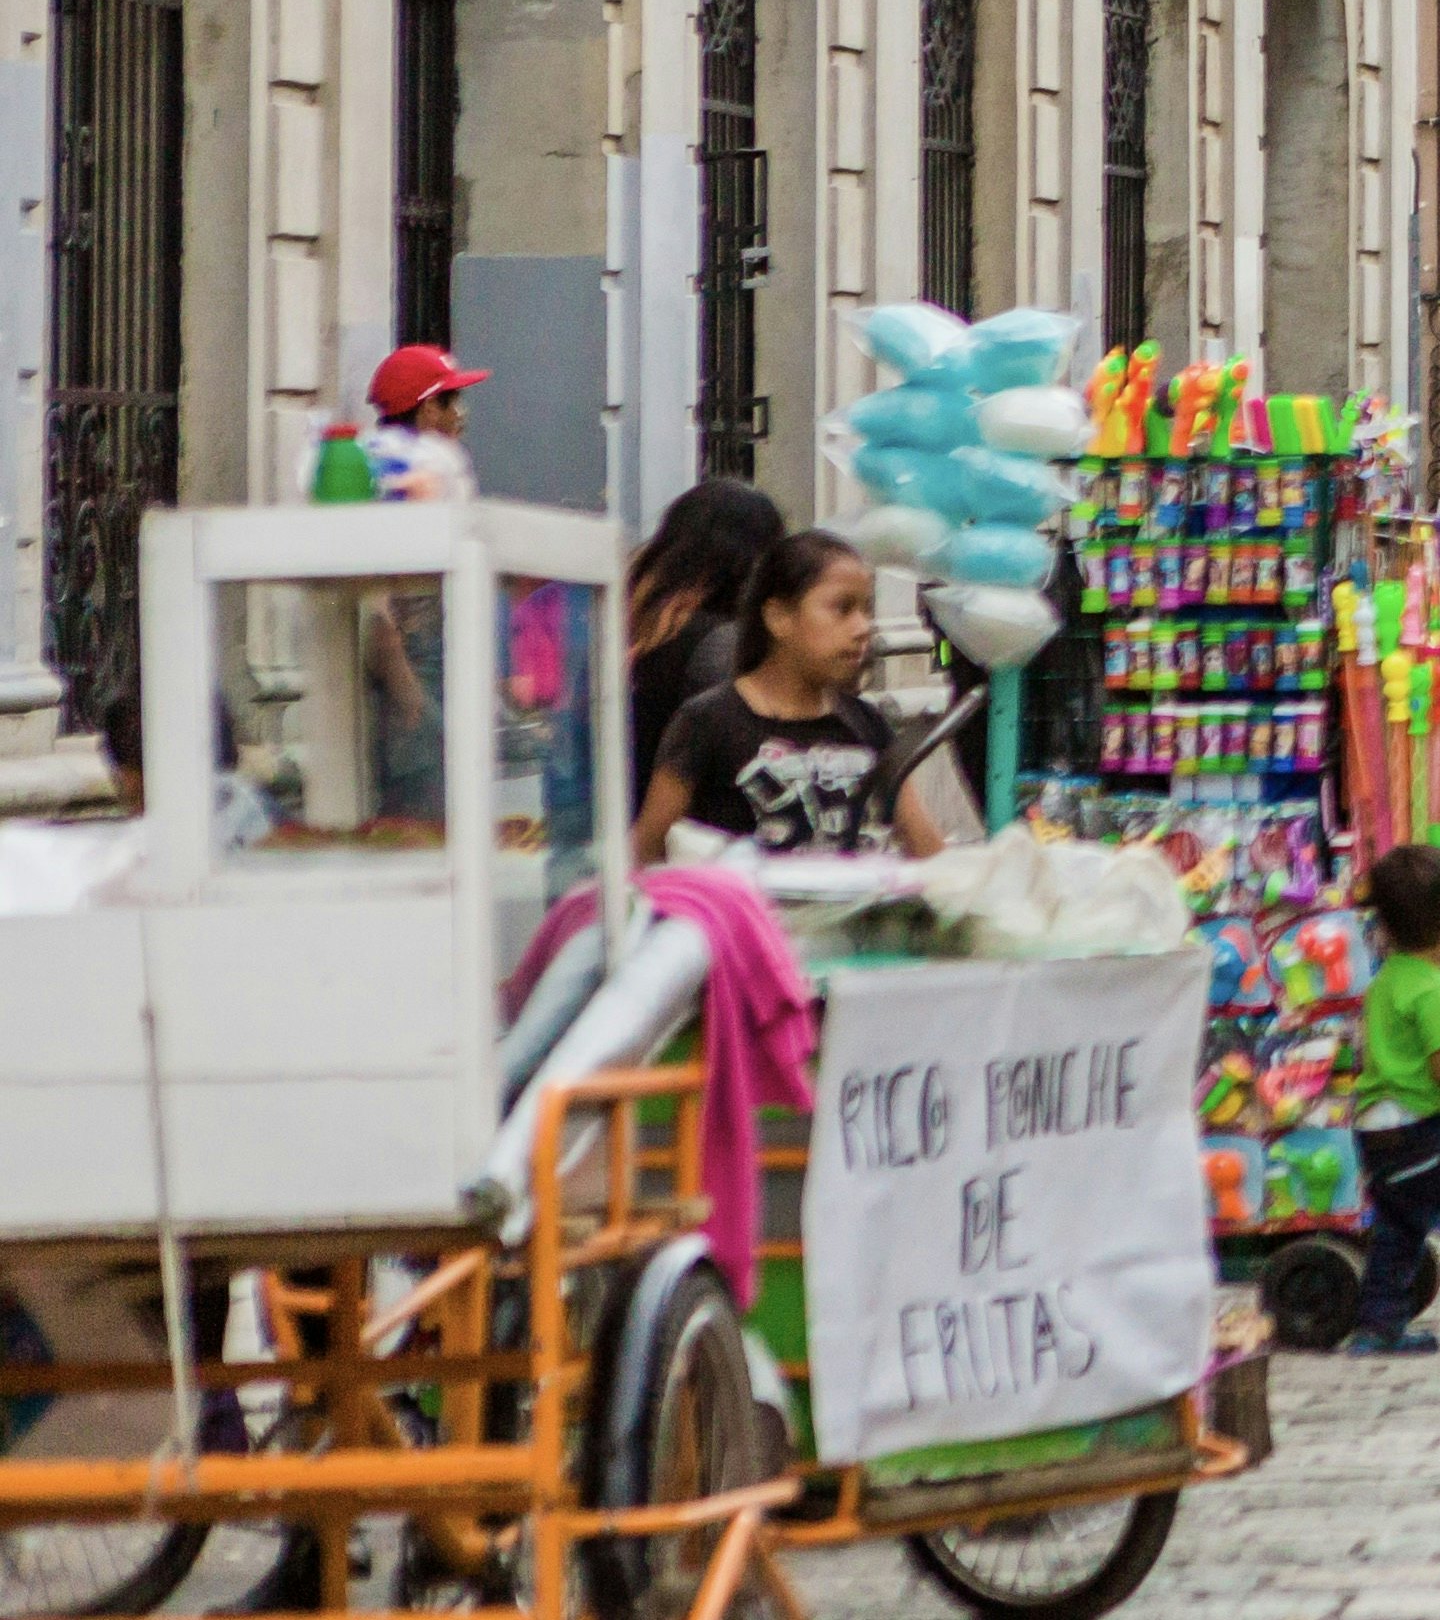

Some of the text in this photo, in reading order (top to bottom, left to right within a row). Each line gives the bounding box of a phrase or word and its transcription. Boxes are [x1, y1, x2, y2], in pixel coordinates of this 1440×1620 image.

[838, 1038, 1144, 1172] RICO PONCHE
[960, 1164, 1031, 1275] DE
[900, 1280, 1097, 1411] FRUTAS
